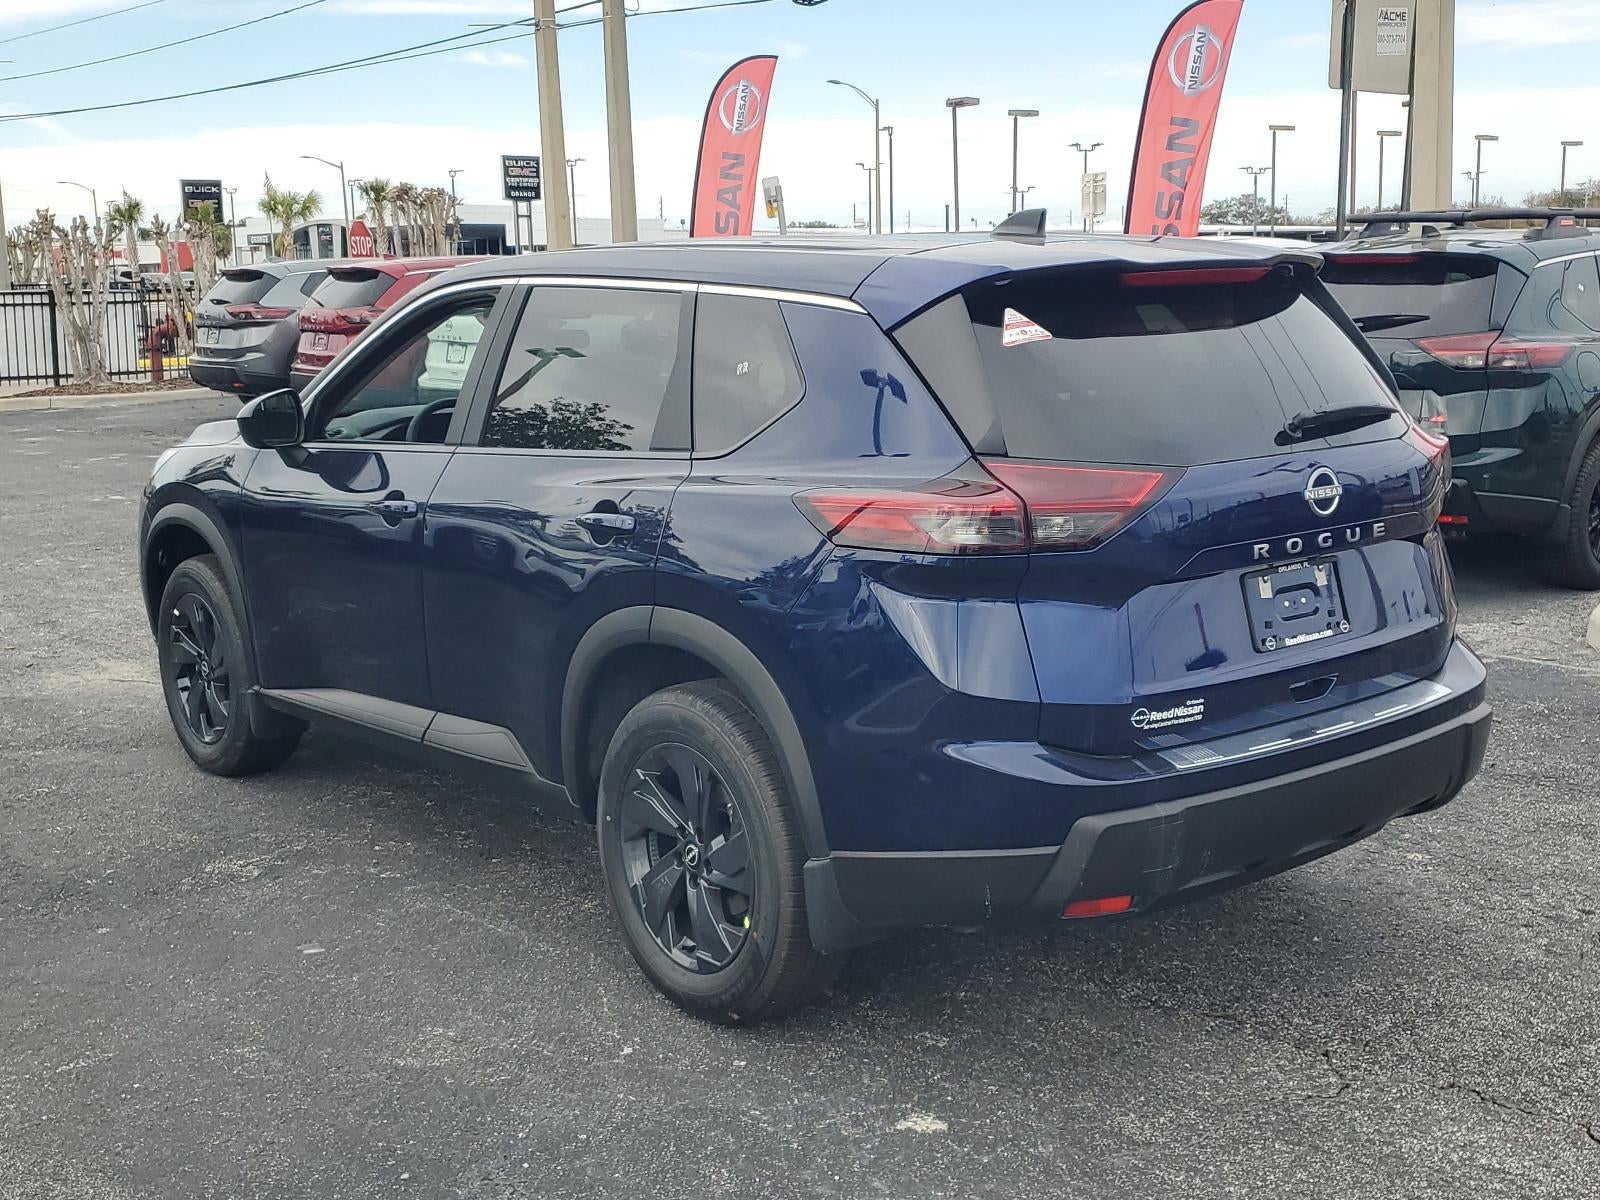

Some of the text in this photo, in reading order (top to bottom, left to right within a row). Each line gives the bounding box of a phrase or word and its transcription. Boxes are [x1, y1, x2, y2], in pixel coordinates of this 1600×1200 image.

[1187, 31, 1207, 90] NISSAN
[735, 84, 749, 132] NISSAN
[508, 167, 537, 176] GMC
[350, 236, 372, 256] STOP
[1304, 486, 1343, 500] NISSAN
[1253, 522, 1386, 559] ROGUE
[1284, 629, 1334, 646] ReedNissan.com
[1186, 698, 1205, 706] Orlando
